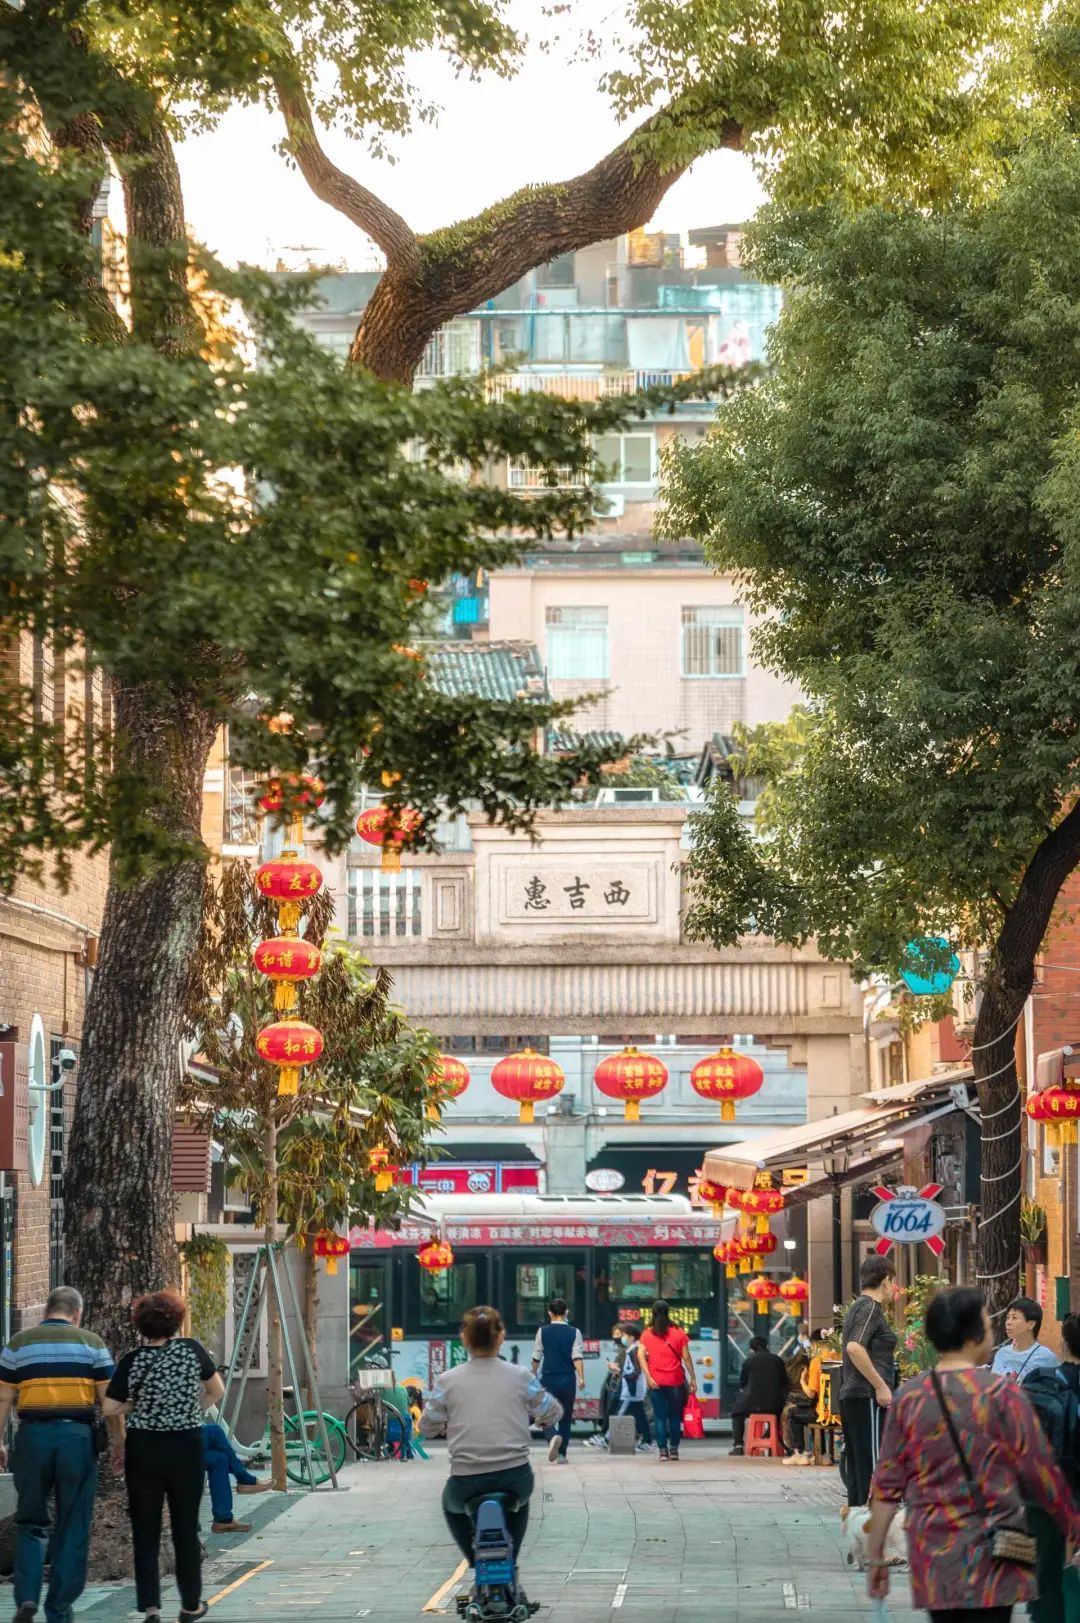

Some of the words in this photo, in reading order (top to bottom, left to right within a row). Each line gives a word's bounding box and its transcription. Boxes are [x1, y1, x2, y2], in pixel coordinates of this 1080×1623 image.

[256, 871, 273, 889] 信
[288, 872, 319, 891] 友善
[523, 876, 631, 910] 惠吉西
[260, 950, 294, 969] 和谐
[283, 1037, 316, 1057] 和谐
[1051, 1096, 1078, 1112] 自由
[884, 1208, 933, 1233] 1664
[618, 1308, 640, 1321] 250
